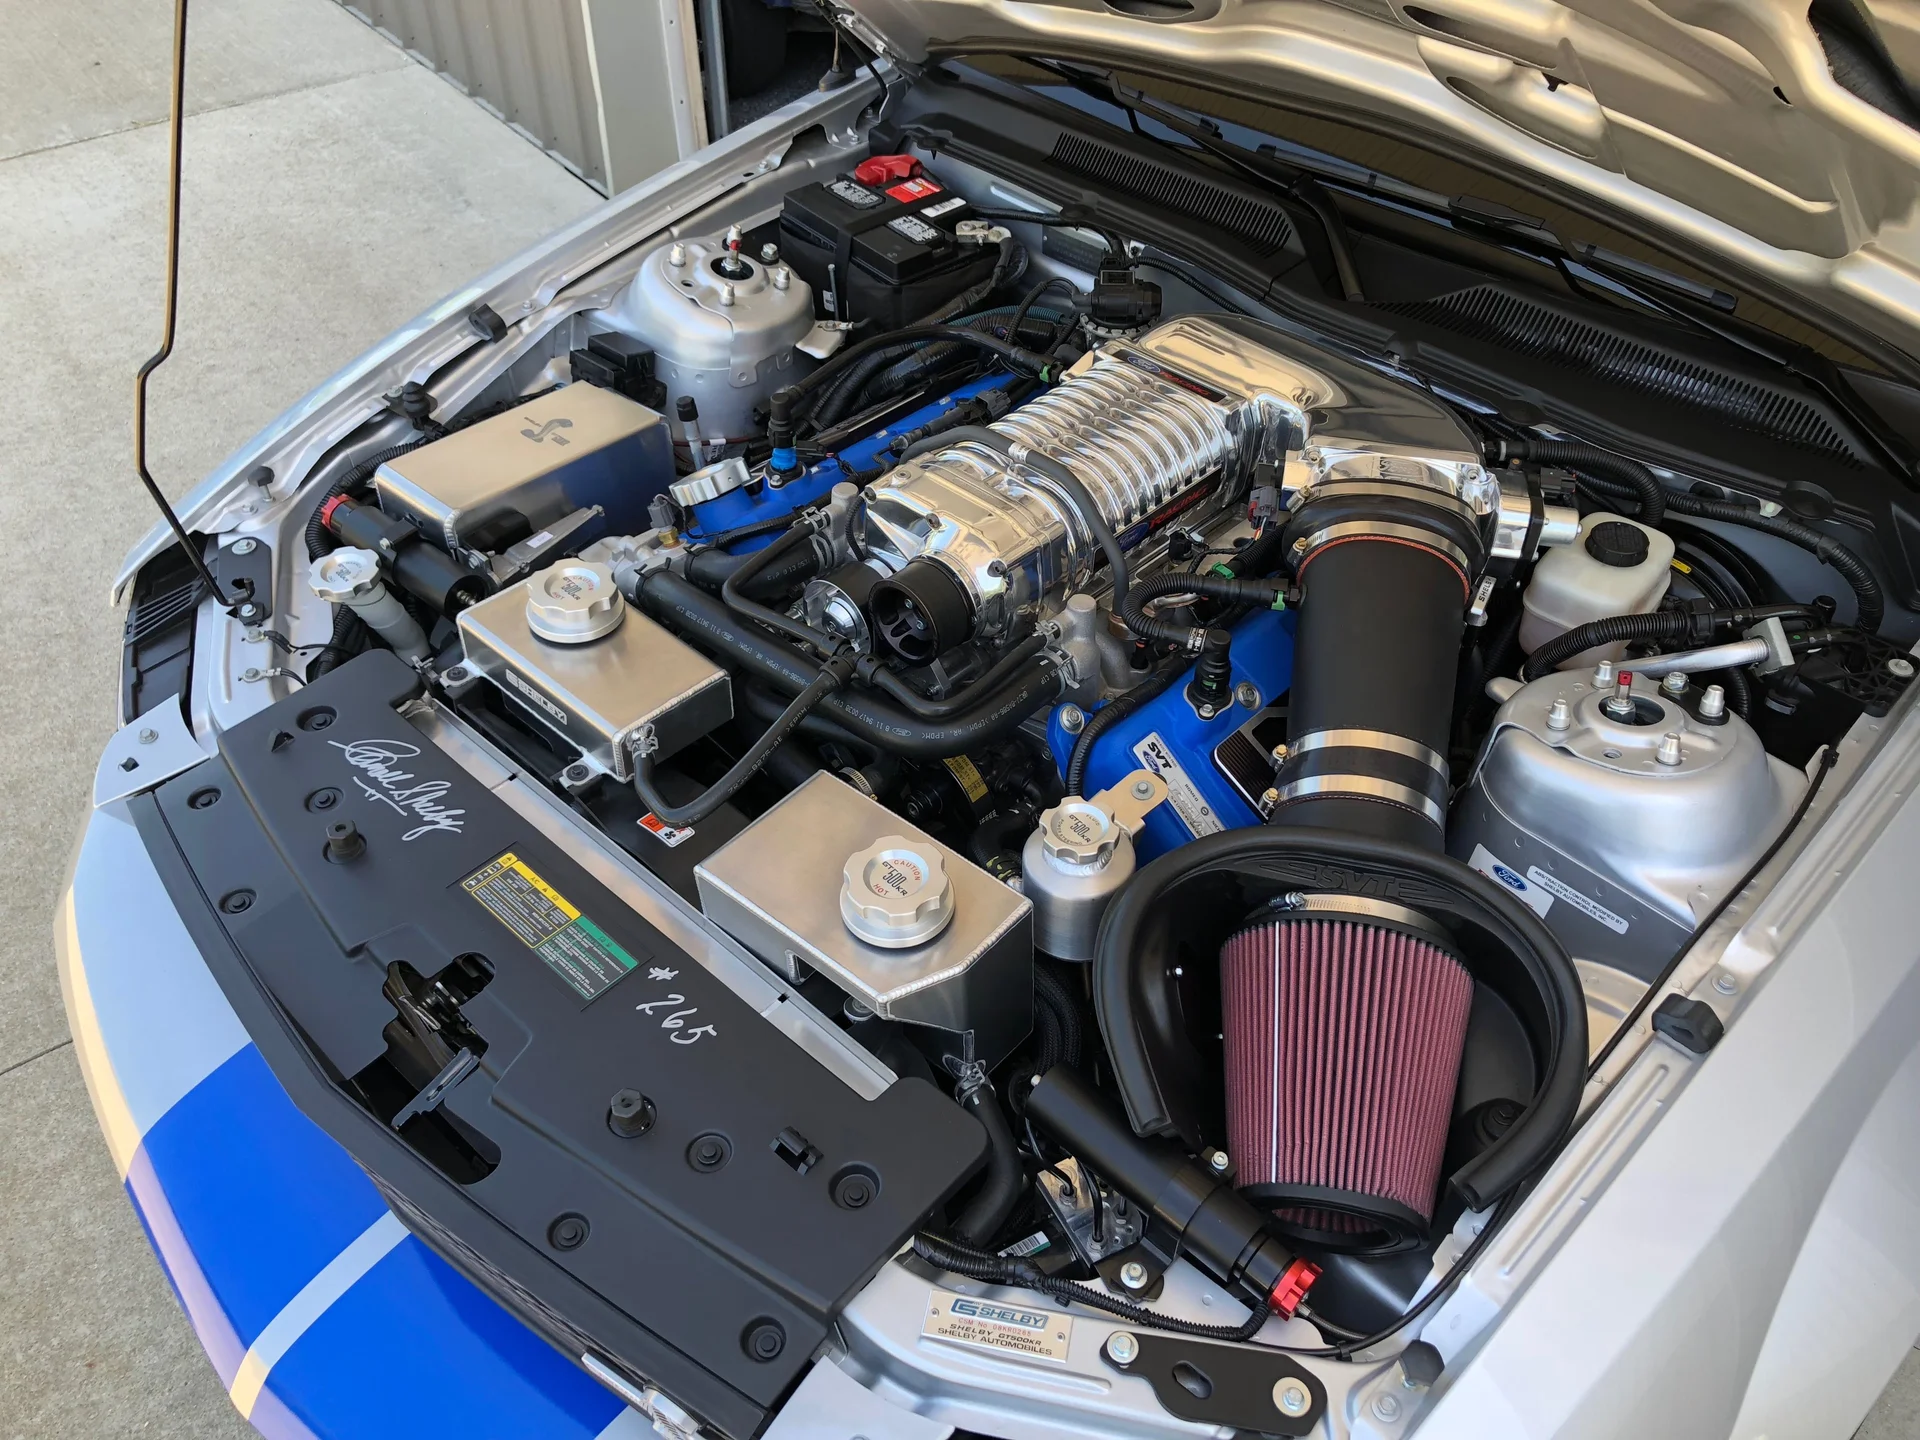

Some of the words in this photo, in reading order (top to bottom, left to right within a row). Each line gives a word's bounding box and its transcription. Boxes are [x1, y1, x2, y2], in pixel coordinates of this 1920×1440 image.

[1149, 483, 1209, 530] RACING
[1147, 741, 1172, 770] SVT
[882, 860, 908, 896] GT500KR
[893, 859, 921, 881] CAUTION
[1317, 865, 1396, 897] SVT
[1497, 867, 1523, 889] Ford
[873, 883, 890, 896] HOT
[1543, 881, 1564, 897] SHELBY
[1568, 888, 1592, 907] CONTROL
[1591, 902, 1616, 922] MODIFIED
[1614, 916, 1624, 926] BY
[635, 993, 718, 1045] 265
[958, 1317, 974, 1327] CSM
[978, 1306, 1045, 1328] SHELBY
[937, 1327, 977, 1341] SHELBY
[979, 1335, 1053, 1356] AUTOMOBILES
[949, 1323, 994, 1336] SHELBY
[998, 1332, 1043, 1347] GT500KR
